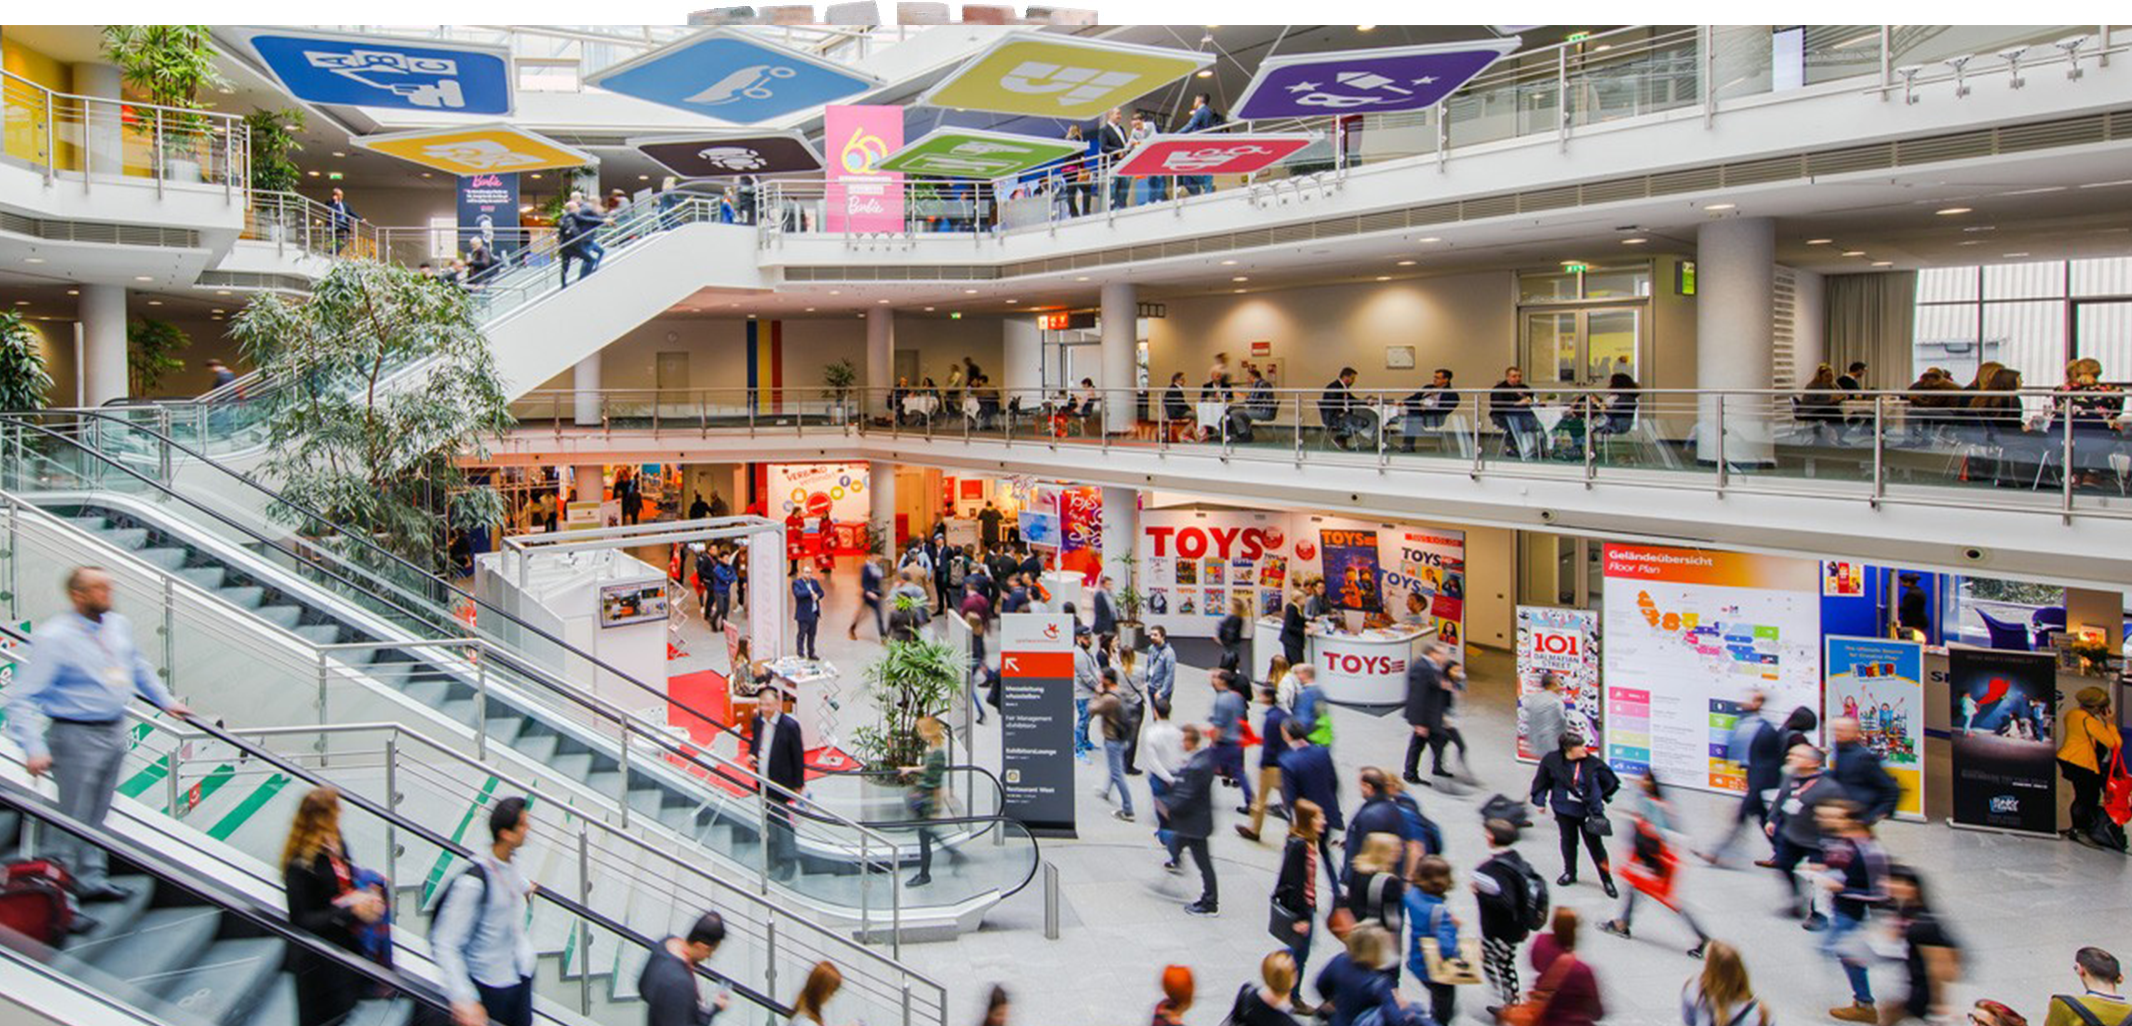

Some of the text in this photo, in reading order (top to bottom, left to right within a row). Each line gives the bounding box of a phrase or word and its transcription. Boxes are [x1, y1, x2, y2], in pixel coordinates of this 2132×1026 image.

[848, 195, 883, 215] Barbie
[1145, 526, 1263, 560] TOYS
[1322, 531, 1364, 546] TOYS
[1402, 546, 1442, 566] TOYS
[1608, 550, 1713, 567] Geländeübersicht
[1608, 563, 1660, 574] Floor Plan
[1378, 568, 1422, 593] TOYS
[1534, 633, 1579, 655] 101
[1323, 651, 1390, 674] TOYS
